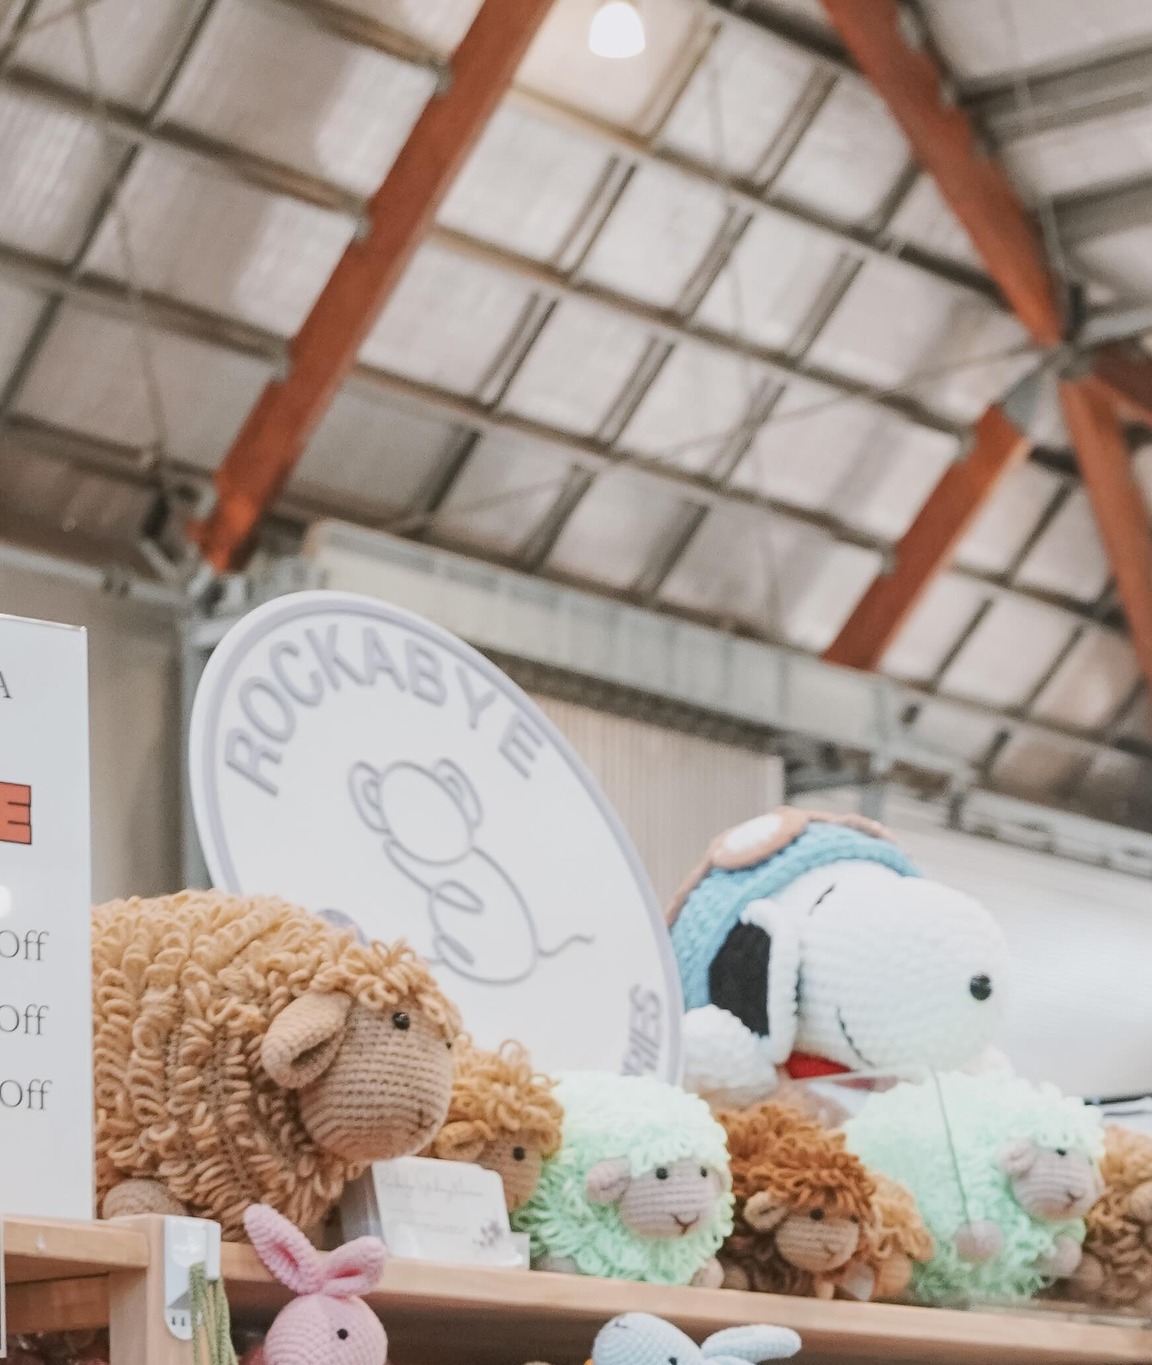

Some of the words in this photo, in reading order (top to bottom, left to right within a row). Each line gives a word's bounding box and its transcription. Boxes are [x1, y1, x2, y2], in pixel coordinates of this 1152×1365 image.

[225, 624, 544, 797] ROCKABYE
[0, 929, 50, 962] Off
[0, 1004, 50, 1035] Off
[0, 1079, 53, 1110] Off
